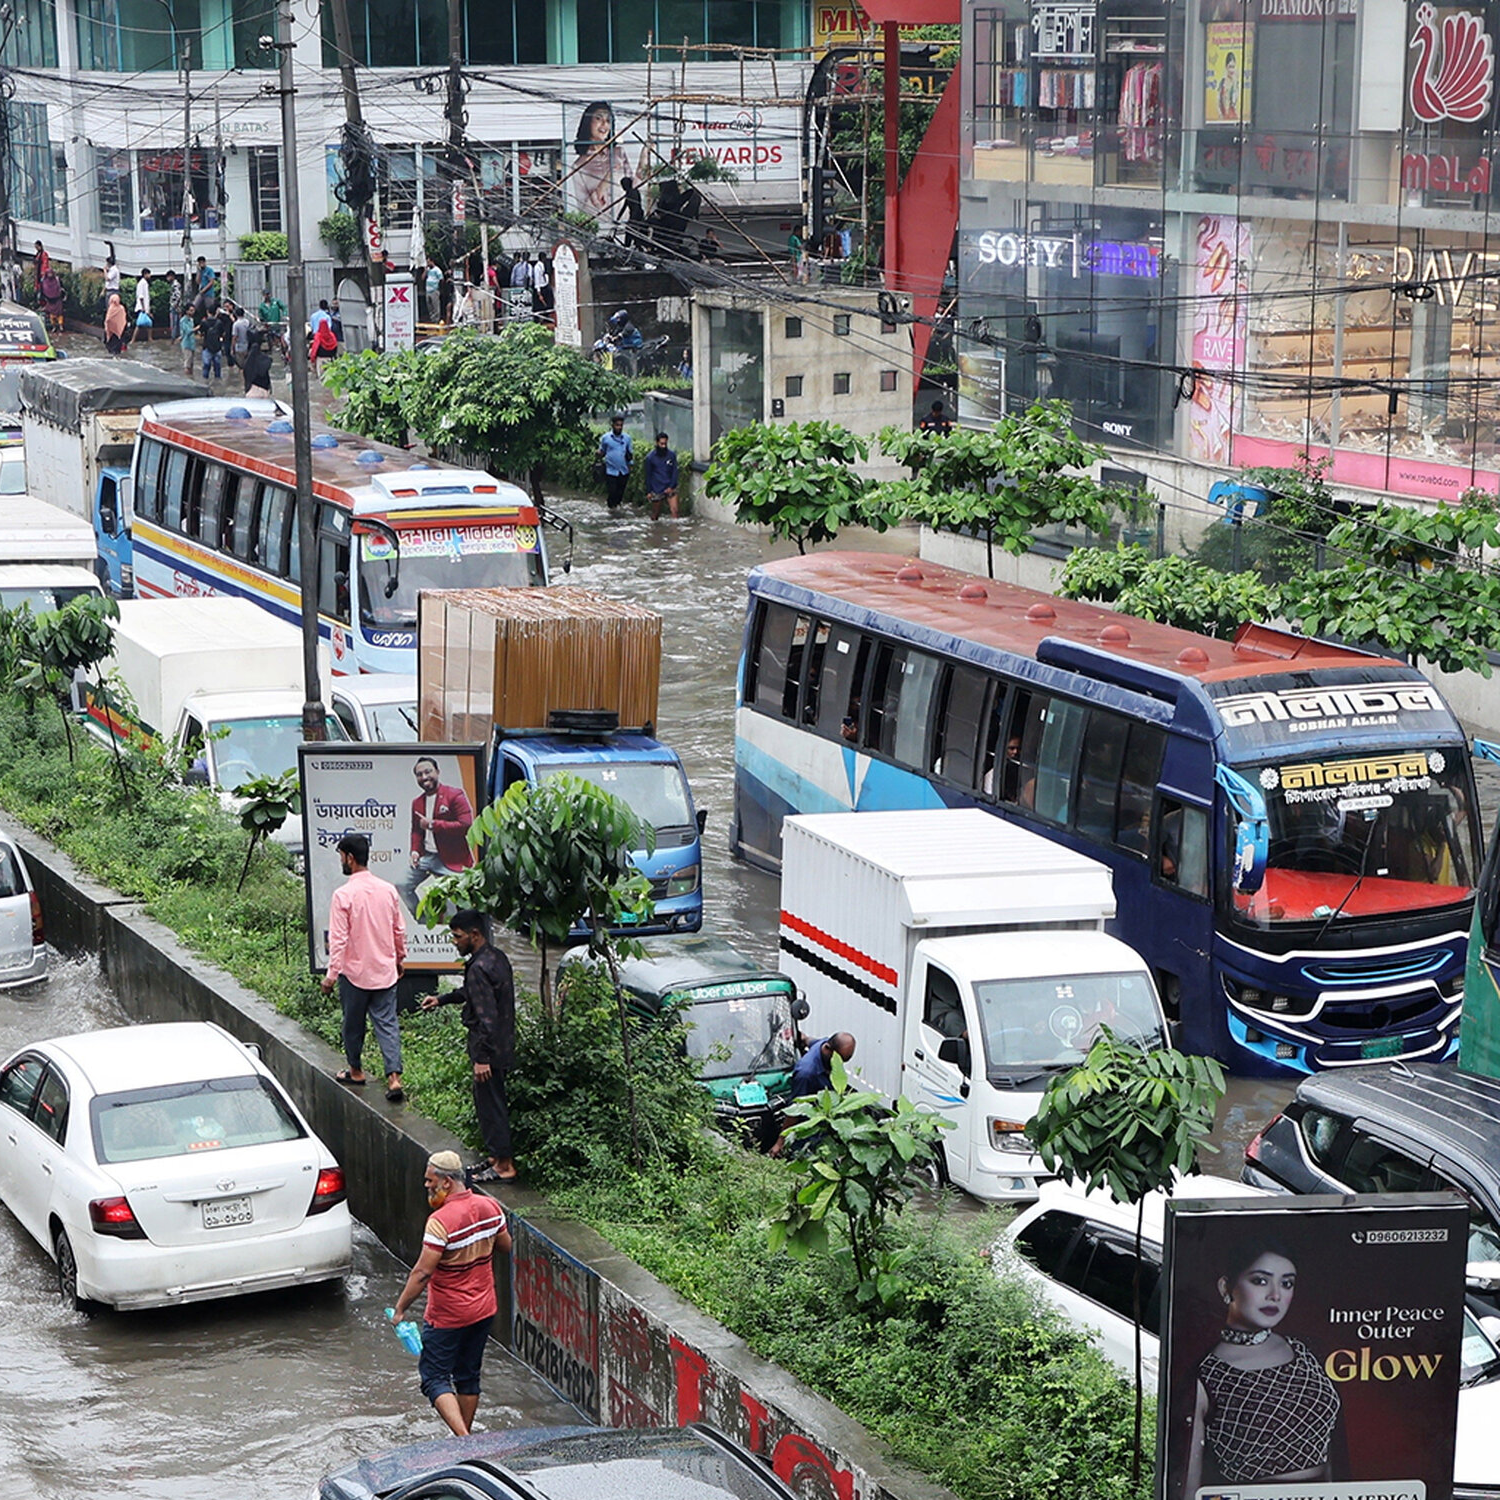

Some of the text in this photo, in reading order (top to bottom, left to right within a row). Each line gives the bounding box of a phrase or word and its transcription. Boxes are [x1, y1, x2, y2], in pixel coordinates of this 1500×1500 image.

[1262, 0, 1335, 16] DIAMOND
[978, 231, 1062, 268] SONY
[1102, 421, 1133, 437] SONY
[1212, 681, 1446, 728] নীলাচল
[1288, 714, 1399, 733] SOBHAN ALLAH
[1280, 752, 1429, 790] নীলাচল
[353, 818, 377, 830] আর
[411, 946, 434, 954] SINCE
[1368, 1229, 1447, 1243] 09606213232
[1329, 1306, 1445, 1323] Inner Peace
[1357, 1323, 1415, 1340] Outer
[1324, 1346, 1443, 1382] Glow
